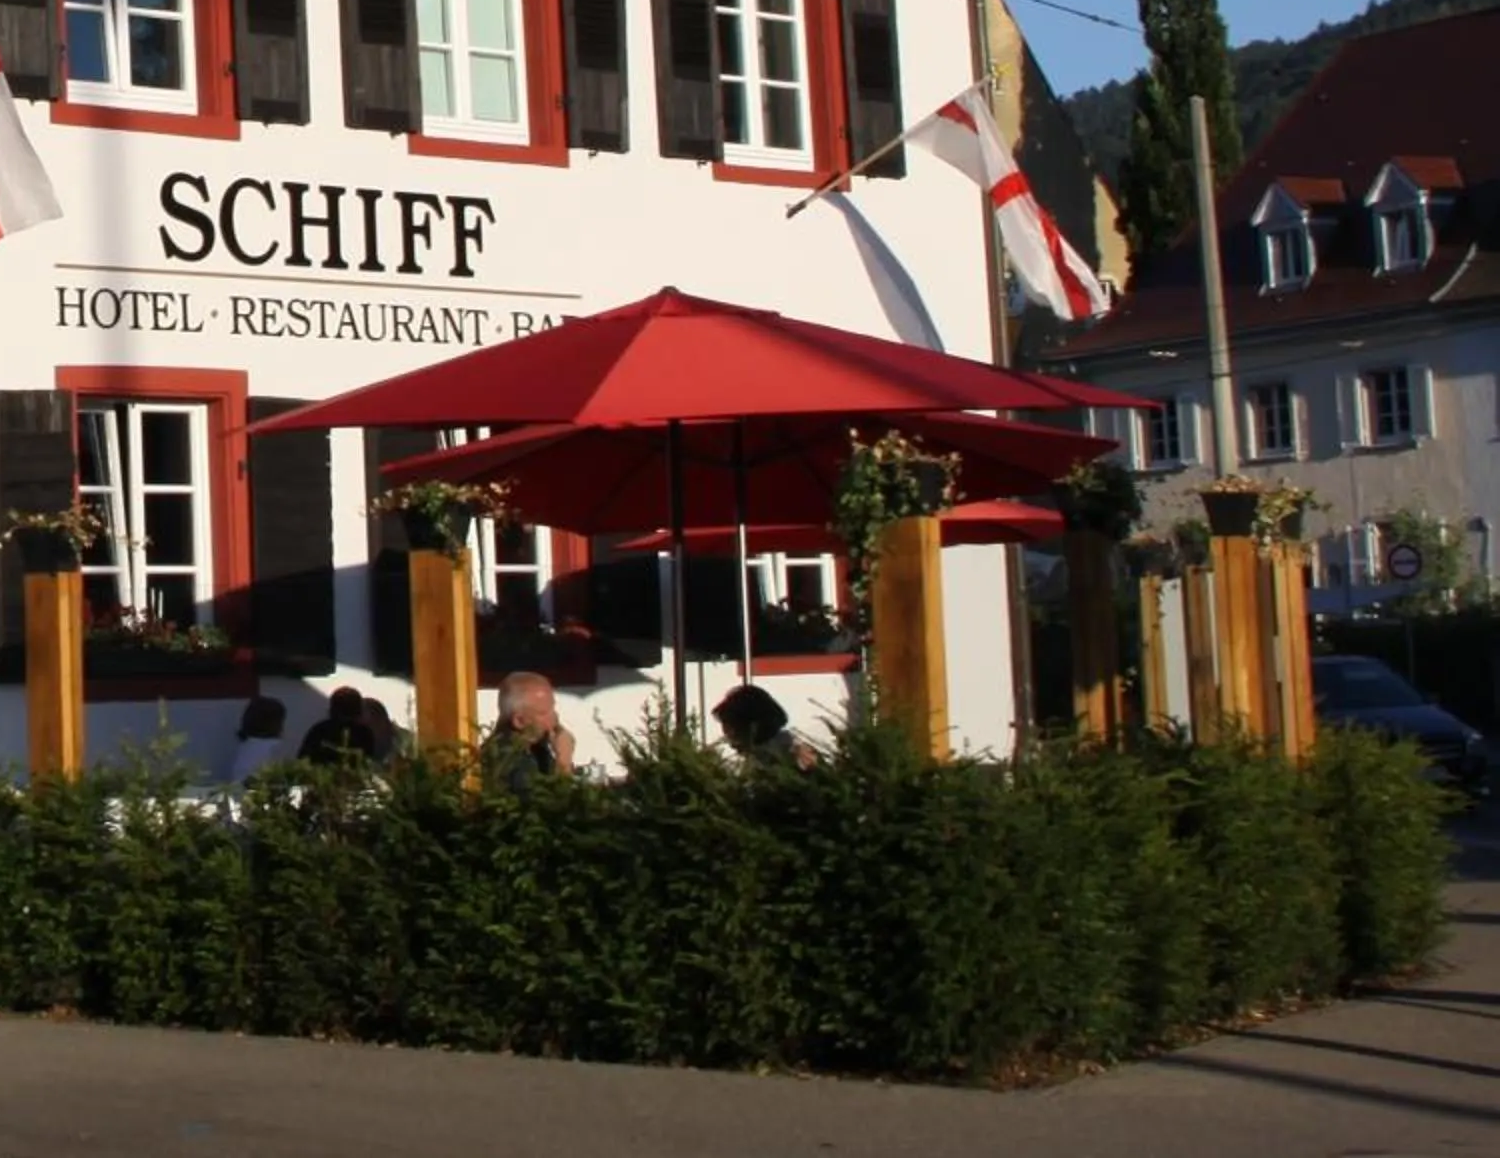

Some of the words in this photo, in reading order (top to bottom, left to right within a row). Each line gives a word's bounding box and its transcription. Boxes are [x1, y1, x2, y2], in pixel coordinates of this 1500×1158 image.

[158, 171, 496, 278] SCHIFF
[54, 286, 204, 333] HOTEL
[229, 295, 490, 347] RESTAURANT
